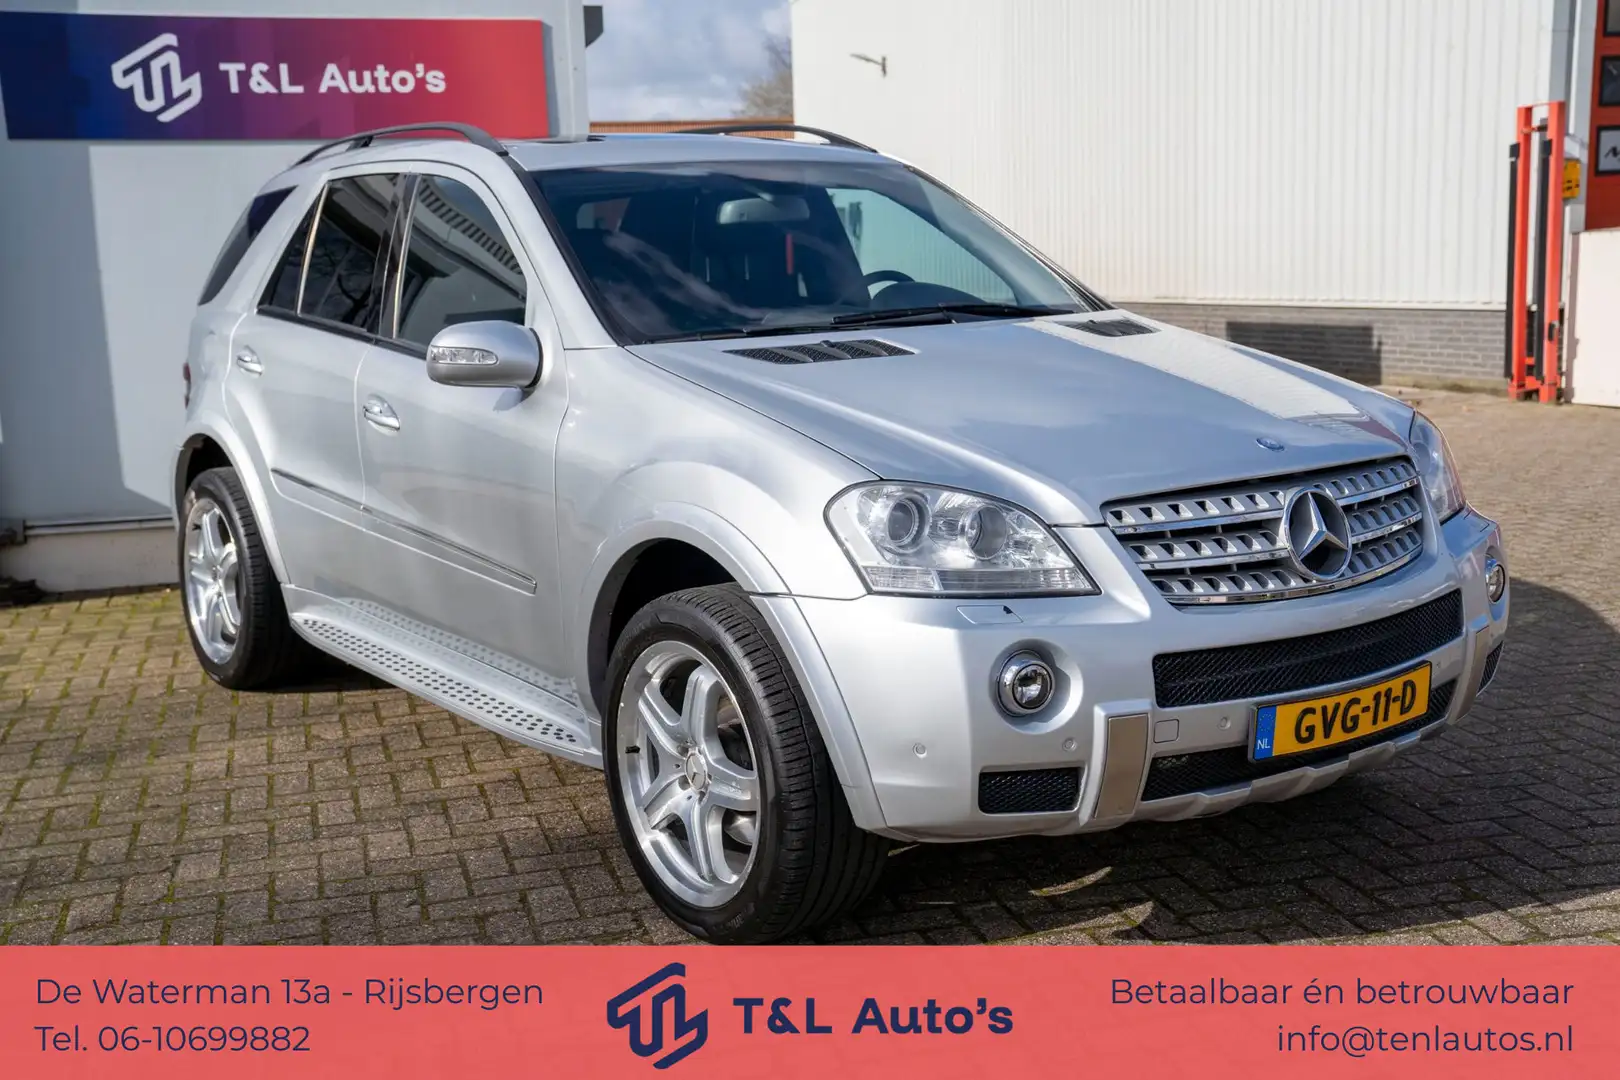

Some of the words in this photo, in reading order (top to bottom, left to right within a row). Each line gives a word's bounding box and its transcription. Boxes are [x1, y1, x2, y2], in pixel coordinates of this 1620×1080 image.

[219, 62, 305, 94] T&L
[1294, 679, 1417, 744] GVG-11-D
[1257, 738, 1271, 750] NL
